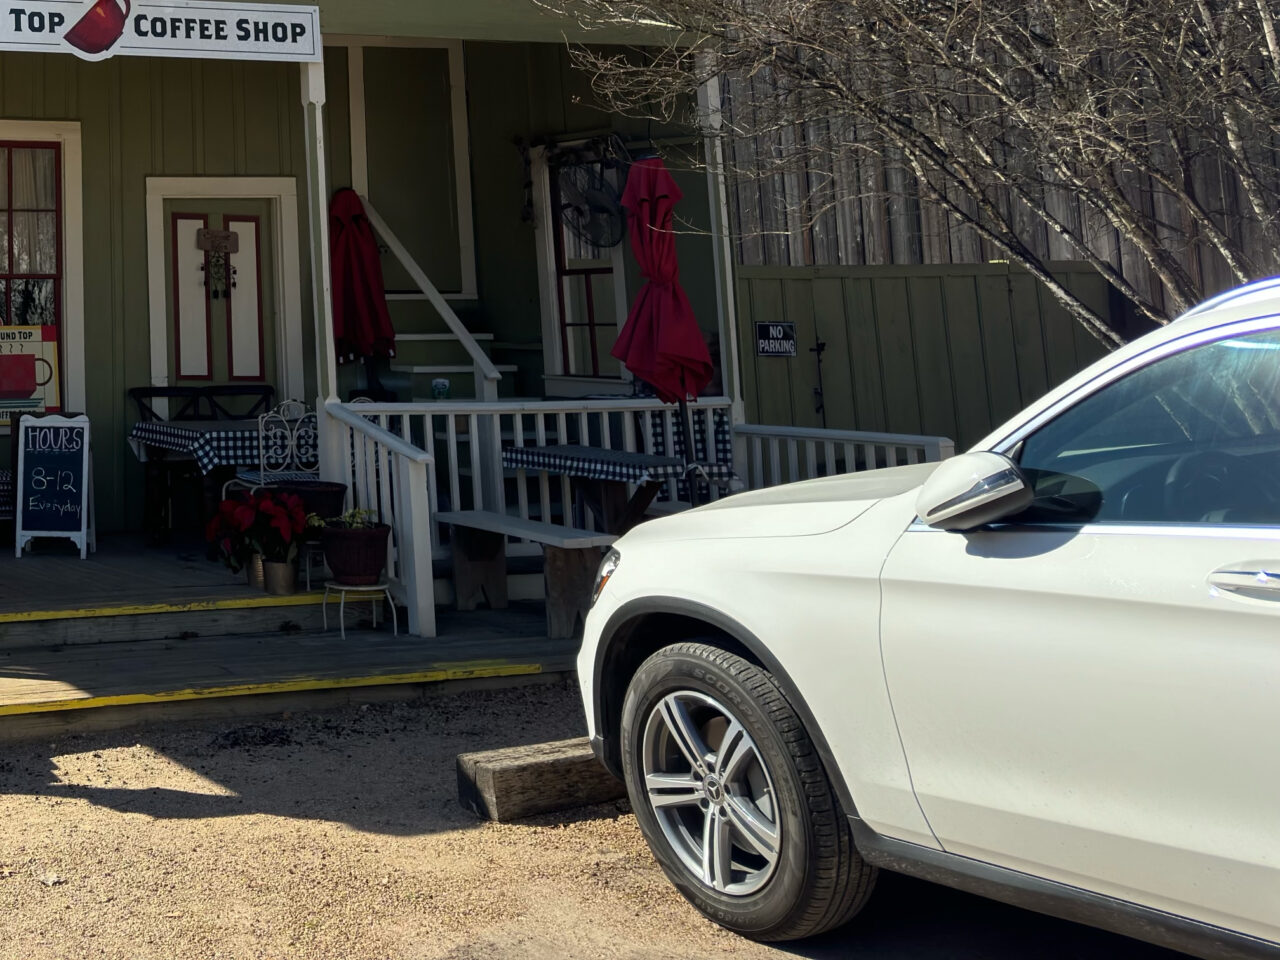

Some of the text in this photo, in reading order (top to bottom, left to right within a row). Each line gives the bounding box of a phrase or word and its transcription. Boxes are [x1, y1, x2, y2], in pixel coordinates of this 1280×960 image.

[9, 8, 65, 33] TOP
[134, 14, 307, 43] COFFEE SHOP
[18, 331, 33, 340] TOP
[769, 325, 783, 338] NO
[759, 339, 795, 353] PARKING
[28, 427, 83, 450] HOURS
[31, 467, 77, 493] 8-12
[29, 495, 81, 519] Everyday
